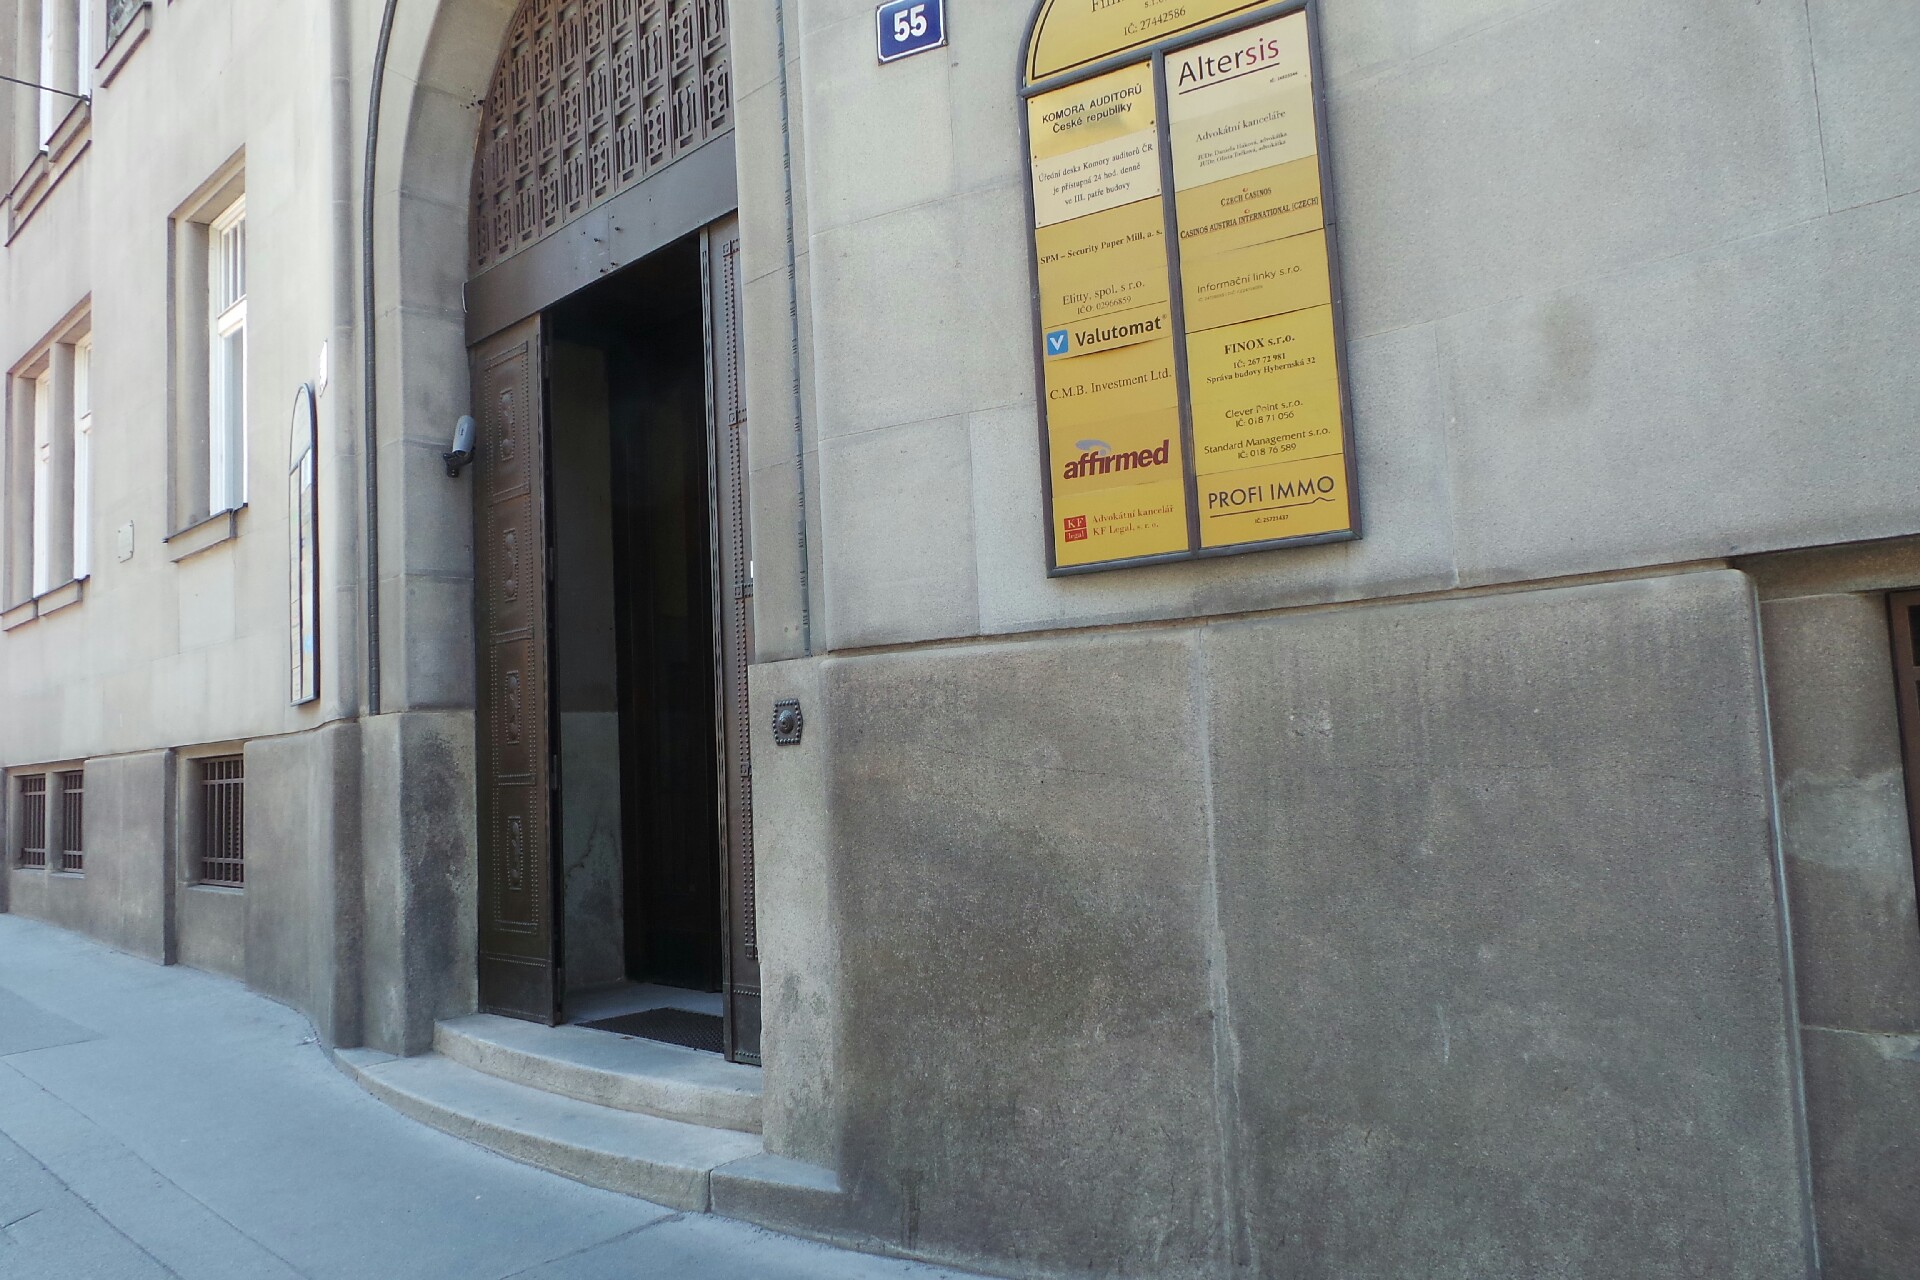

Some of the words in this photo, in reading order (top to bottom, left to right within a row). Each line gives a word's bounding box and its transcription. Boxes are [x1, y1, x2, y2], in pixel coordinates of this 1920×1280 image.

[894, 4, 927, 42] 55
[1124, 22, 1138, 36] IČ:
[1140, 6, 1186, 31] 27442586
[1179, 38, 1279, 87] Altersis
[1042, 105, 1085, 124] KOMORA
[1052, 117, 1083, 134] České
[1086, 102, 1133, 123] republiky
[1196, 121, 1240, 142] Advokátní
[1243, 110, 1286, 128] kanceláře
[1062, 164, 1081, 176] deska
[1083, 156, 1110, 170] Komory
[1112, 146, 1140, 161] auditorů
[1142, 143, 1154, 154] ČR
[1053, 184, 1060, 195] je
[1094, 174, 1102, 183] 24
[1104, 170, 1118, 180] hod.
[1120, 163, 1141, 175] denně
[1065, 197, 1072, 205] ve
[1087, 188, 1104, 201] patře
[1106, 182, 1131, 194] budovy
[1220, 192, 1244, 207] CZECH
[1244, 187, 1272, 201] CASINOS
[1180, 225, 1208, 239] CASINOS
[1209, 218, 1237, 231] AUSTRIA
[1238, 204, 1291, 226] INTERNATIONAL
[1040, 253, 1059, 265] SPM
[1067, 244, 1099, 259] Security
[1101, 238, 1124, 250] Paper
[1126, 231, 1146, 243] Mill,
[1197, 274, 1251, 294] Informační
[1253, 270, 1276, 282] linky
[1279, 264, 1303, 276] s.r.o.
[1224, 337, 1265, 355] FINOX
[1268, 334, 1295, 346] s.r.o.
[1206, 372, 1233, 384] Správa
[1234, 367, 1262, 379] budovy
[1263, 359, 1305, 374] Hybernská
[1306, 356, 1316, 365] 32
[1247, 356, 1261, 366] 267
[1262, 354, 1272, 363] 72
[1272, 352, 1286, 361] 981
[1050, 384, 1088, 400] C.M.B.
[1091, 374, 1148, 393] Investment
[1151, 367, 1172, 382] Ltd.
[1225, 407, 1253, 419] Clever
[1256, 402, 1279, 414] Point
[1281, 399, 1303, 410] s.r.o.
[1247, 415, 1264, 426] 018
[1266, 413, 1276, 422] 71
[1277, 410, 1295, 420] 056
[1204, 440, 1243, 455] Standard
[1245, 431, 1306, 448] Management
[1308, 427, 1331, 437] s.r.o.
[1249, 447, 1266, 457] 018
[1268, 446, 1279, 455] 76
[1280, 442, 1297, 452] 589
[1063, 439, 1170, 480] affirmed
[1208, 485, 1263, 510] PROFI
[1270, 475, 1335, 501] IMMO
[1068, 517, 1085, 529] KF
[1092, 510, 1136, 524] Advokátní
[1137, 504, 1174, 517] kancelář
[1068, 530, 1085, 541] legal
[1092, 527, 1107, 537] KF
